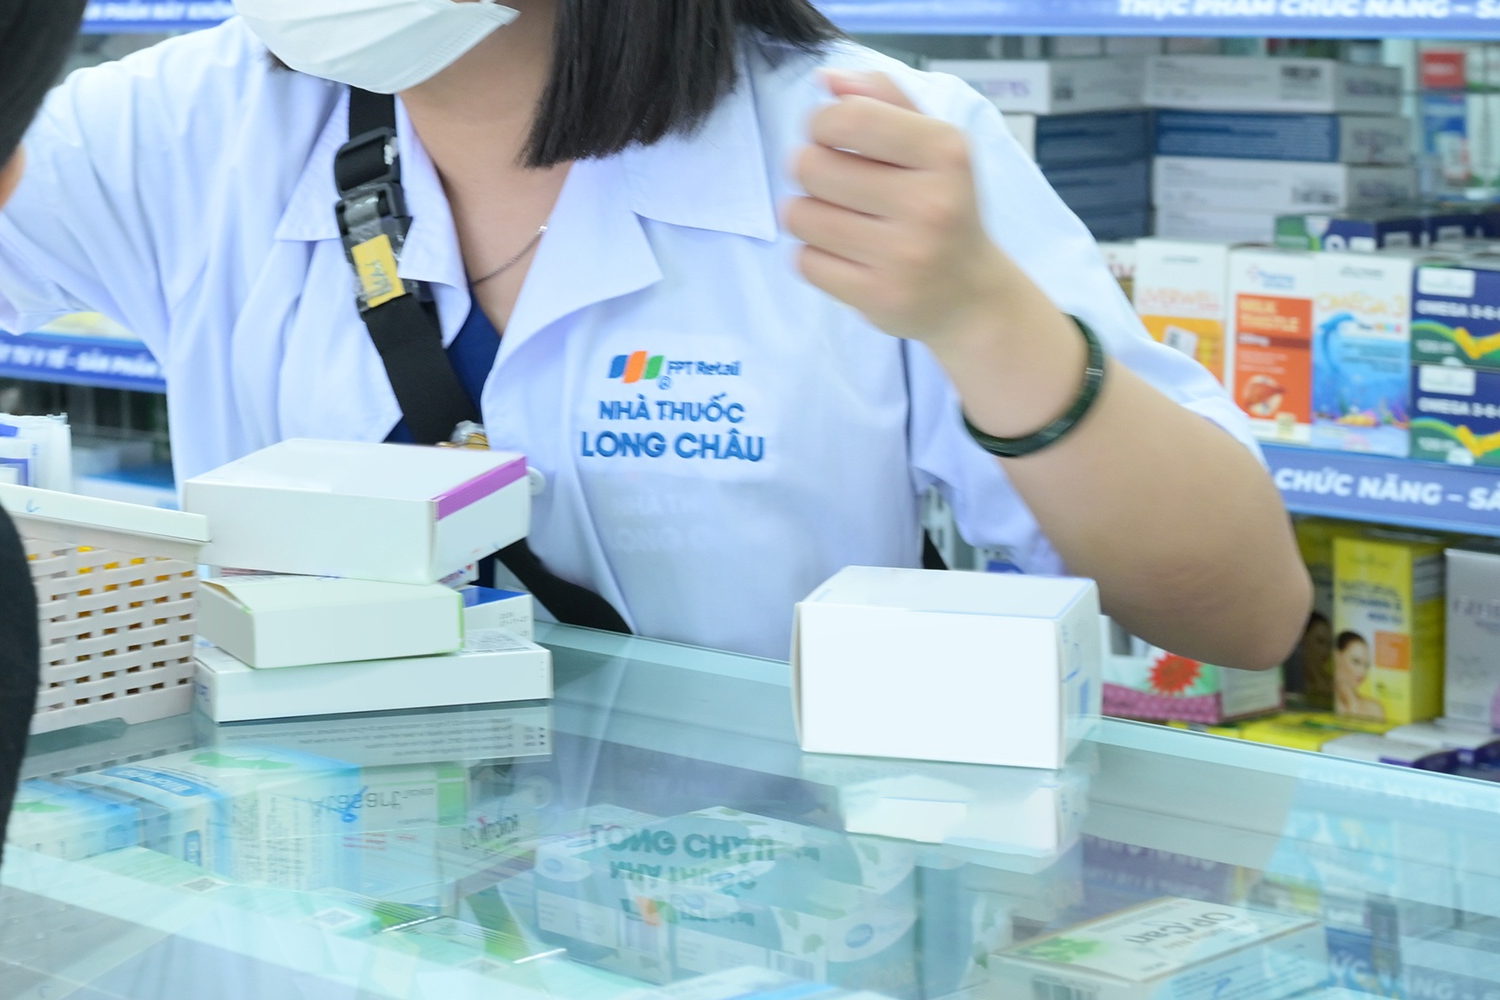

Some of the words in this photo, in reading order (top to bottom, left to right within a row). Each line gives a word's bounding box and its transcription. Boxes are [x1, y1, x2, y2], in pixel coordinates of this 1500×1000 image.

[1415, 299, 1469, 318] OMEGA
[667, 360, 694, 375] FPT
[697, 360, 741, 376] Retail
[598, 393, 651, 420] NHÀ
[656, 392, 745, 424] THUỐC
[1417, 397, 1471, 416] OMEGA
[580, 430, 667, 458] LONG
[674, 427, 765, 462] CHÂU
[1274, 466, 1353, 497] CHỨC
[1356, 473, 1444, 506] NĂNG
